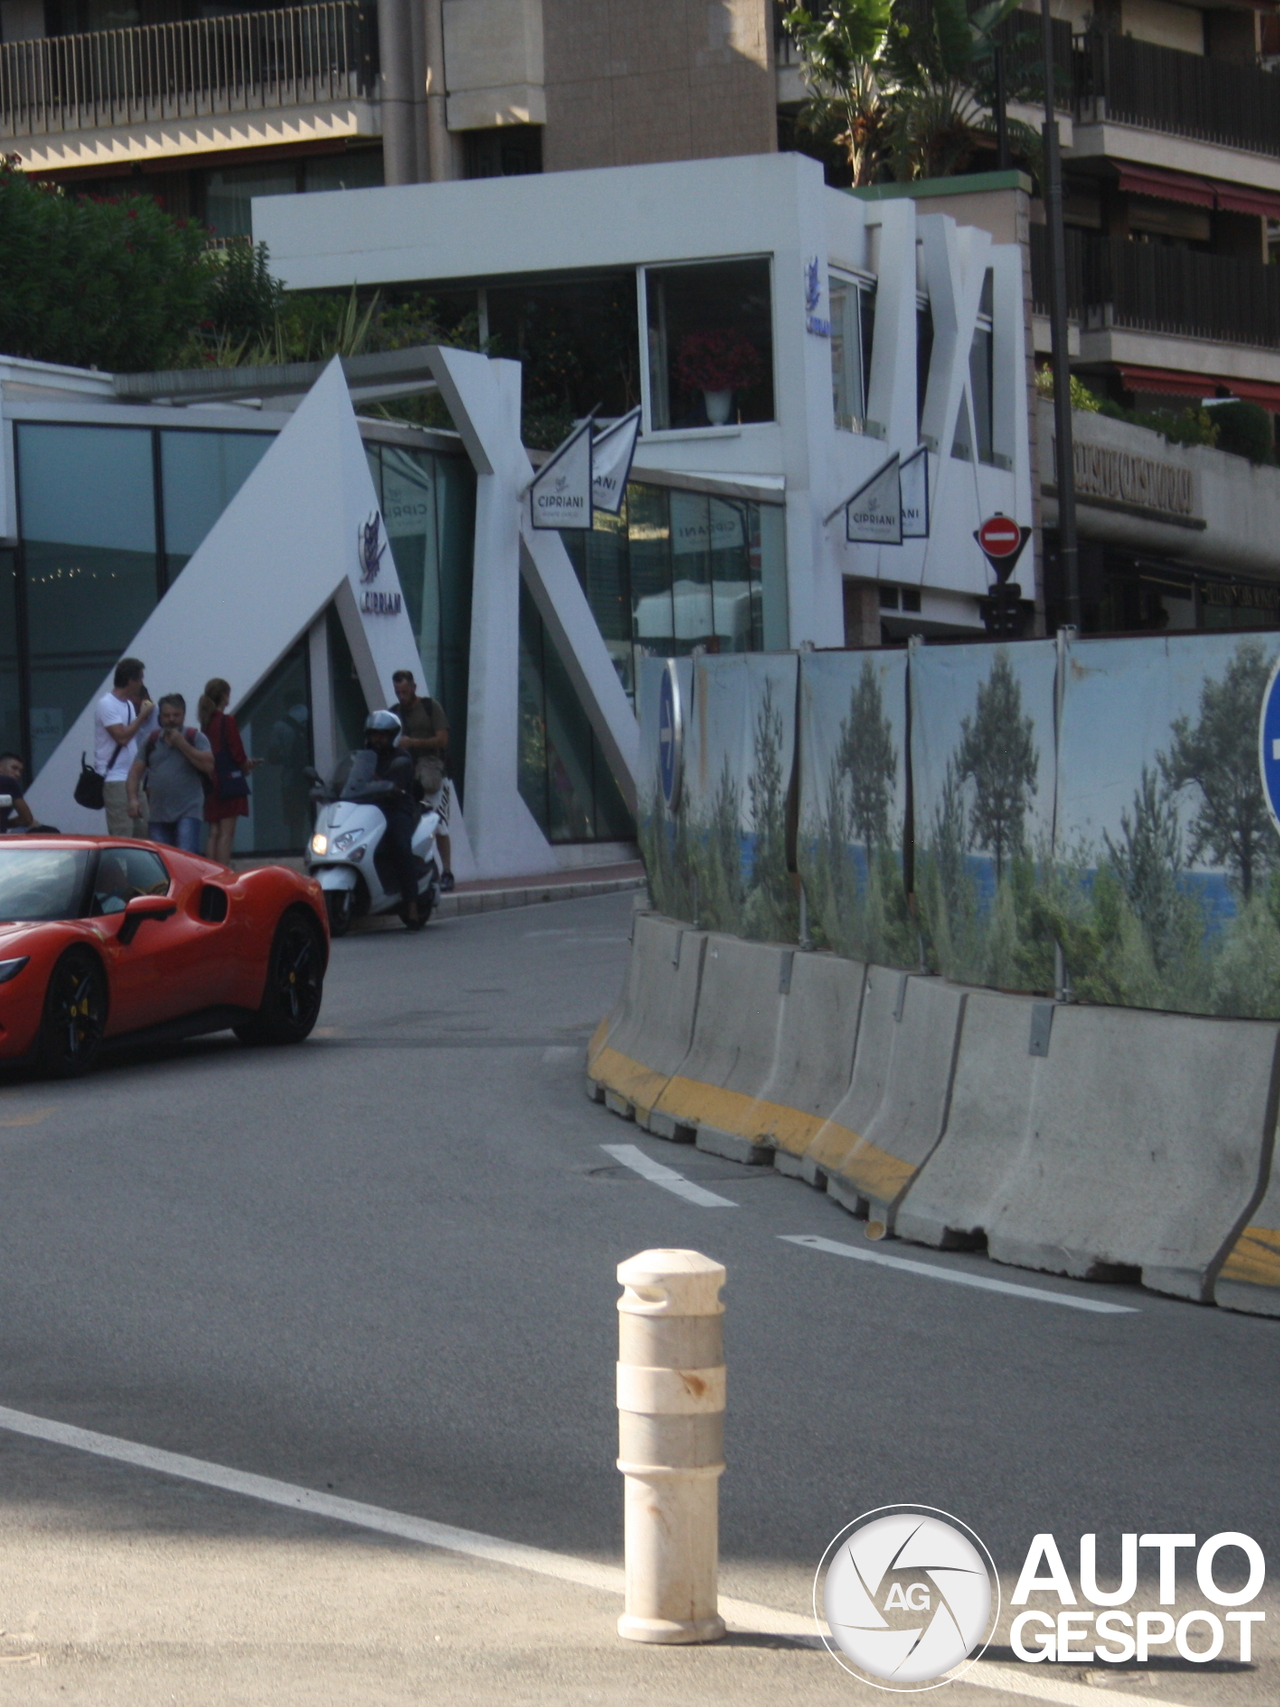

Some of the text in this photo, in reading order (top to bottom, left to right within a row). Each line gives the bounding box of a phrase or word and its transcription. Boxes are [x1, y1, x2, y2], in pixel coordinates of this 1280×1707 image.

[593, 475, 616, 491] ANI
[538, 495, 584, 508] CIPRIANI
[853, 513, 895, 526] CIPRIANI
